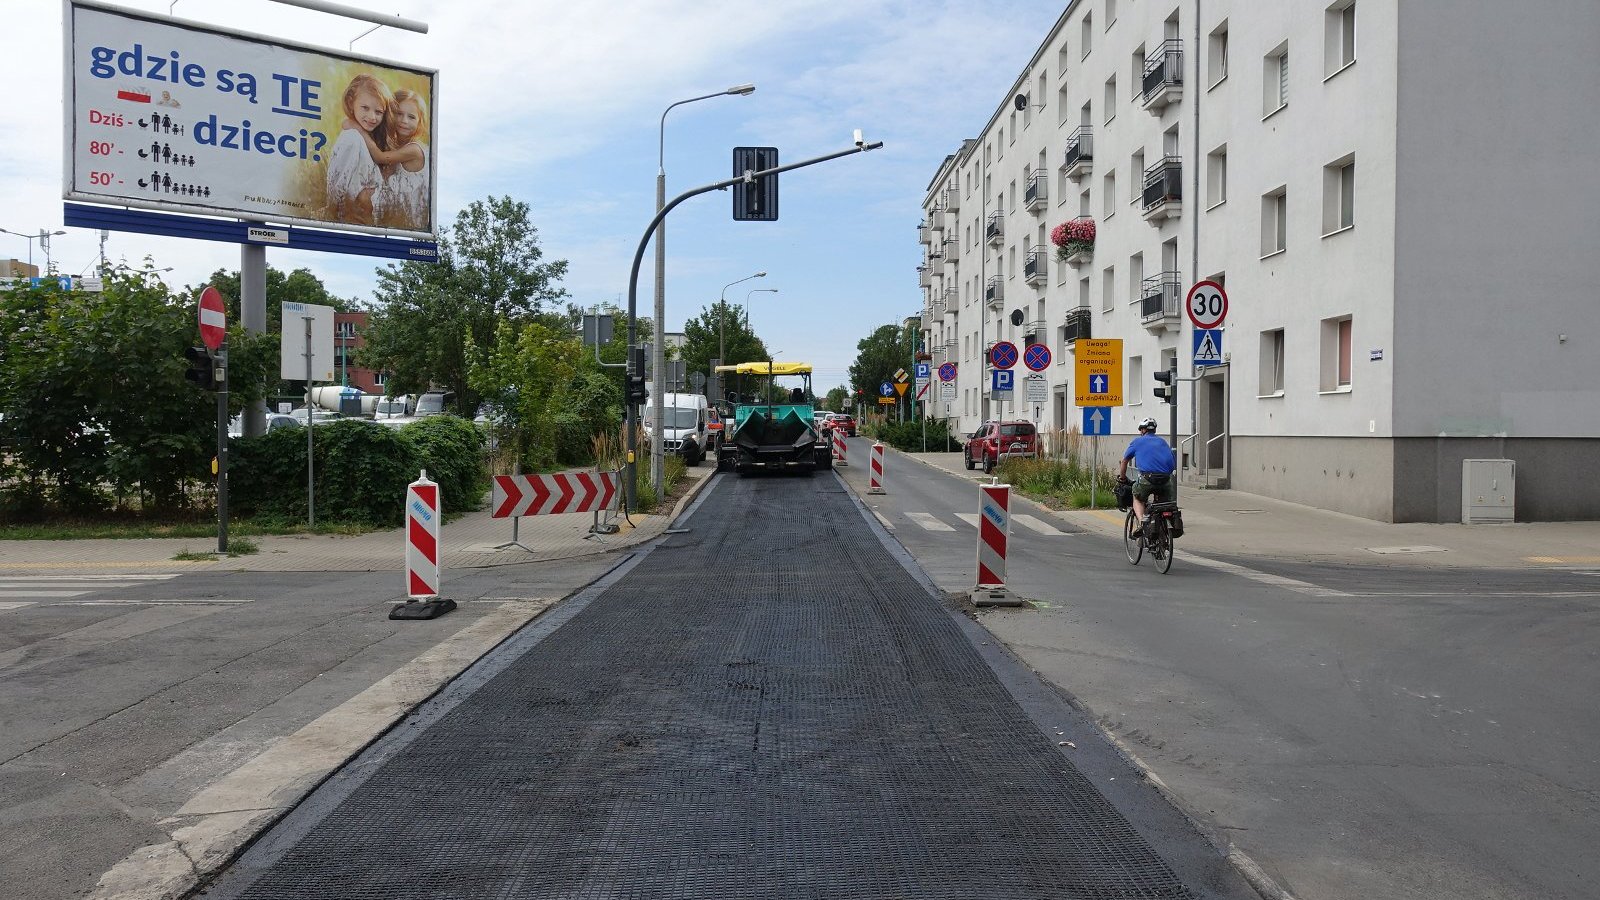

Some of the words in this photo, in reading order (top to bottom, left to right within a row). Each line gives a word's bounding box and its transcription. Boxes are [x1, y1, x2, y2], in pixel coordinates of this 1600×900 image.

[90, 43, 206, 87] gdzie
[216, 69, 258, 104] są
[272, 73, 321, 113] TE
[89, 109, 124, 127] Dziś
[193, 114, 327, 162] dzieci?
[1193, 292, 1223, 317] 30
[1079, 358, 1116, 366] organizacji
